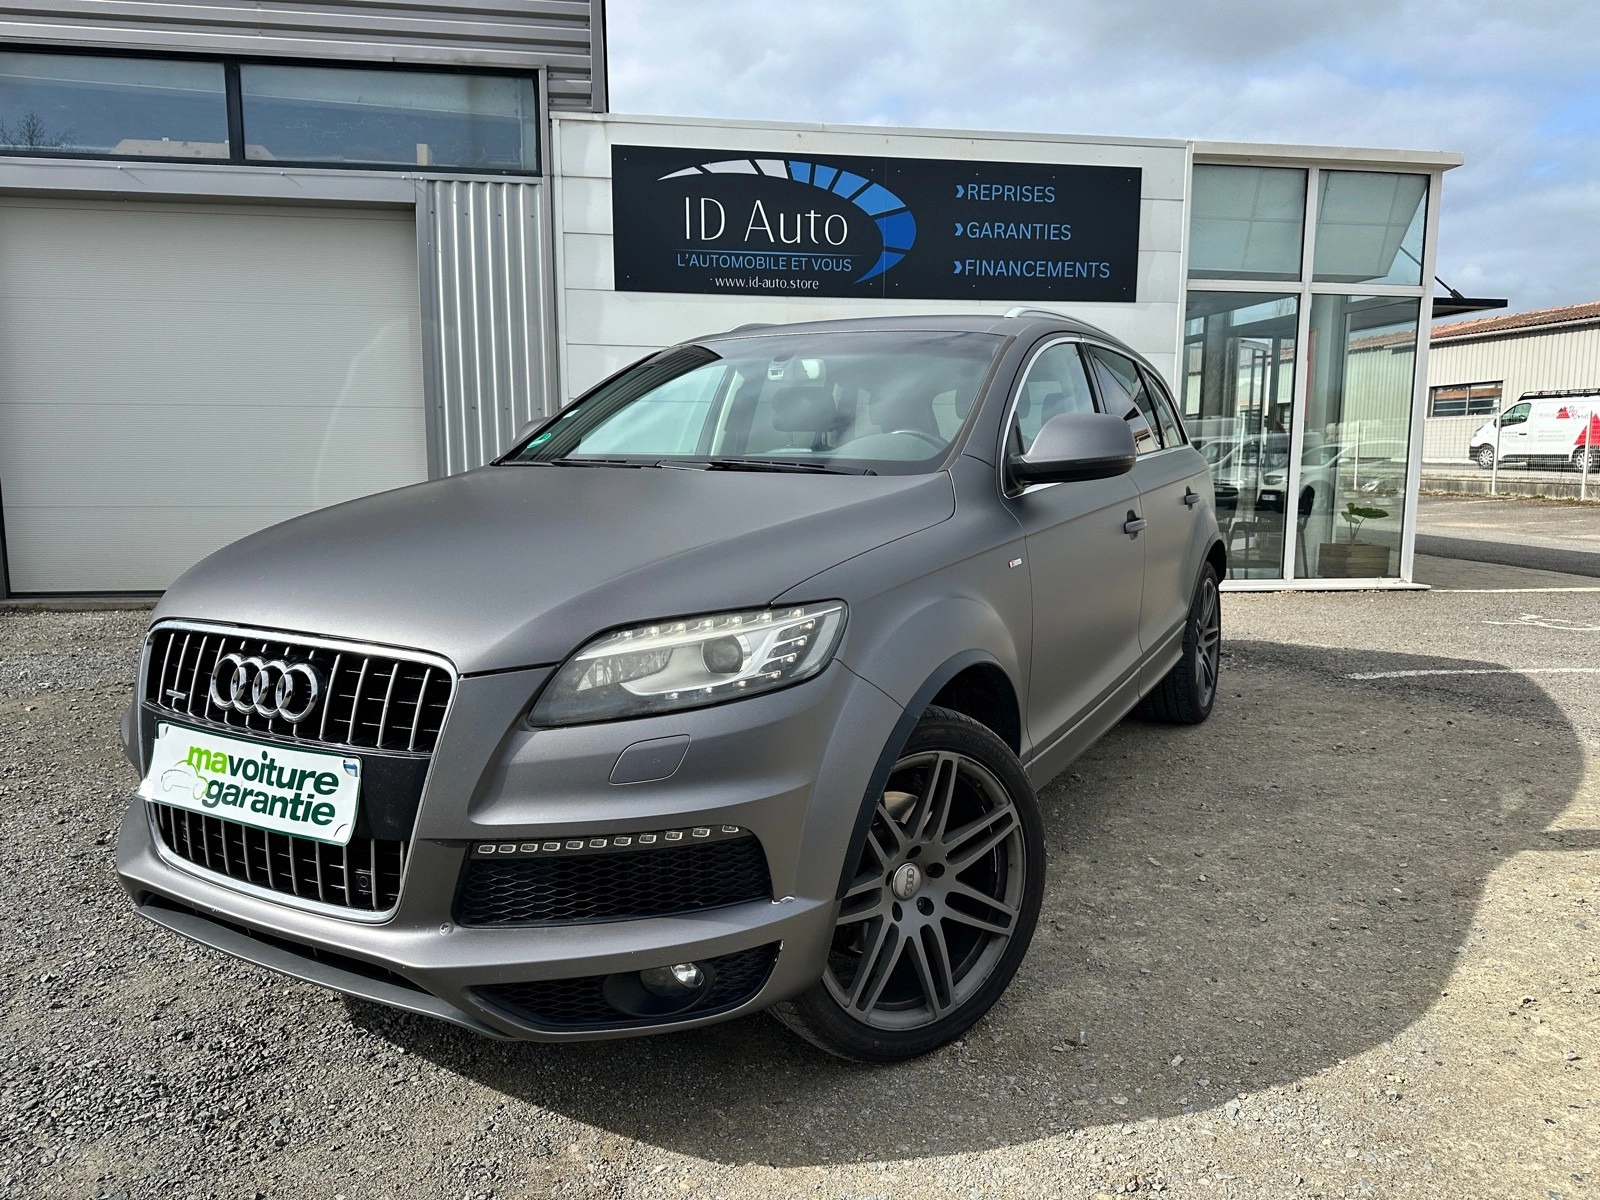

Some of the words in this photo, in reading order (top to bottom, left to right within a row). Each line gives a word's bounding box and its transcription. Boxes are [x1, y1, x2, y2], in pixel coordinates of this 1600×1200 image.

[967, 184, 1055, 202] REPRISES
[685, 197, 726, 241] ID
[744, 199, 848, 246] Auto
[966, 221, 1072, 241] GARANTIES
[677, 253, 787, 270] L'AUTOMOBILE
[791, 257, 807, 270] ET
[812, 258, 852, 272] VOUS
[965, 259, 1110, 279] FINANCEMENTS
[715, 276, 819, 290] www.id-auto.store
[201, 779, 336, 826] garantie
